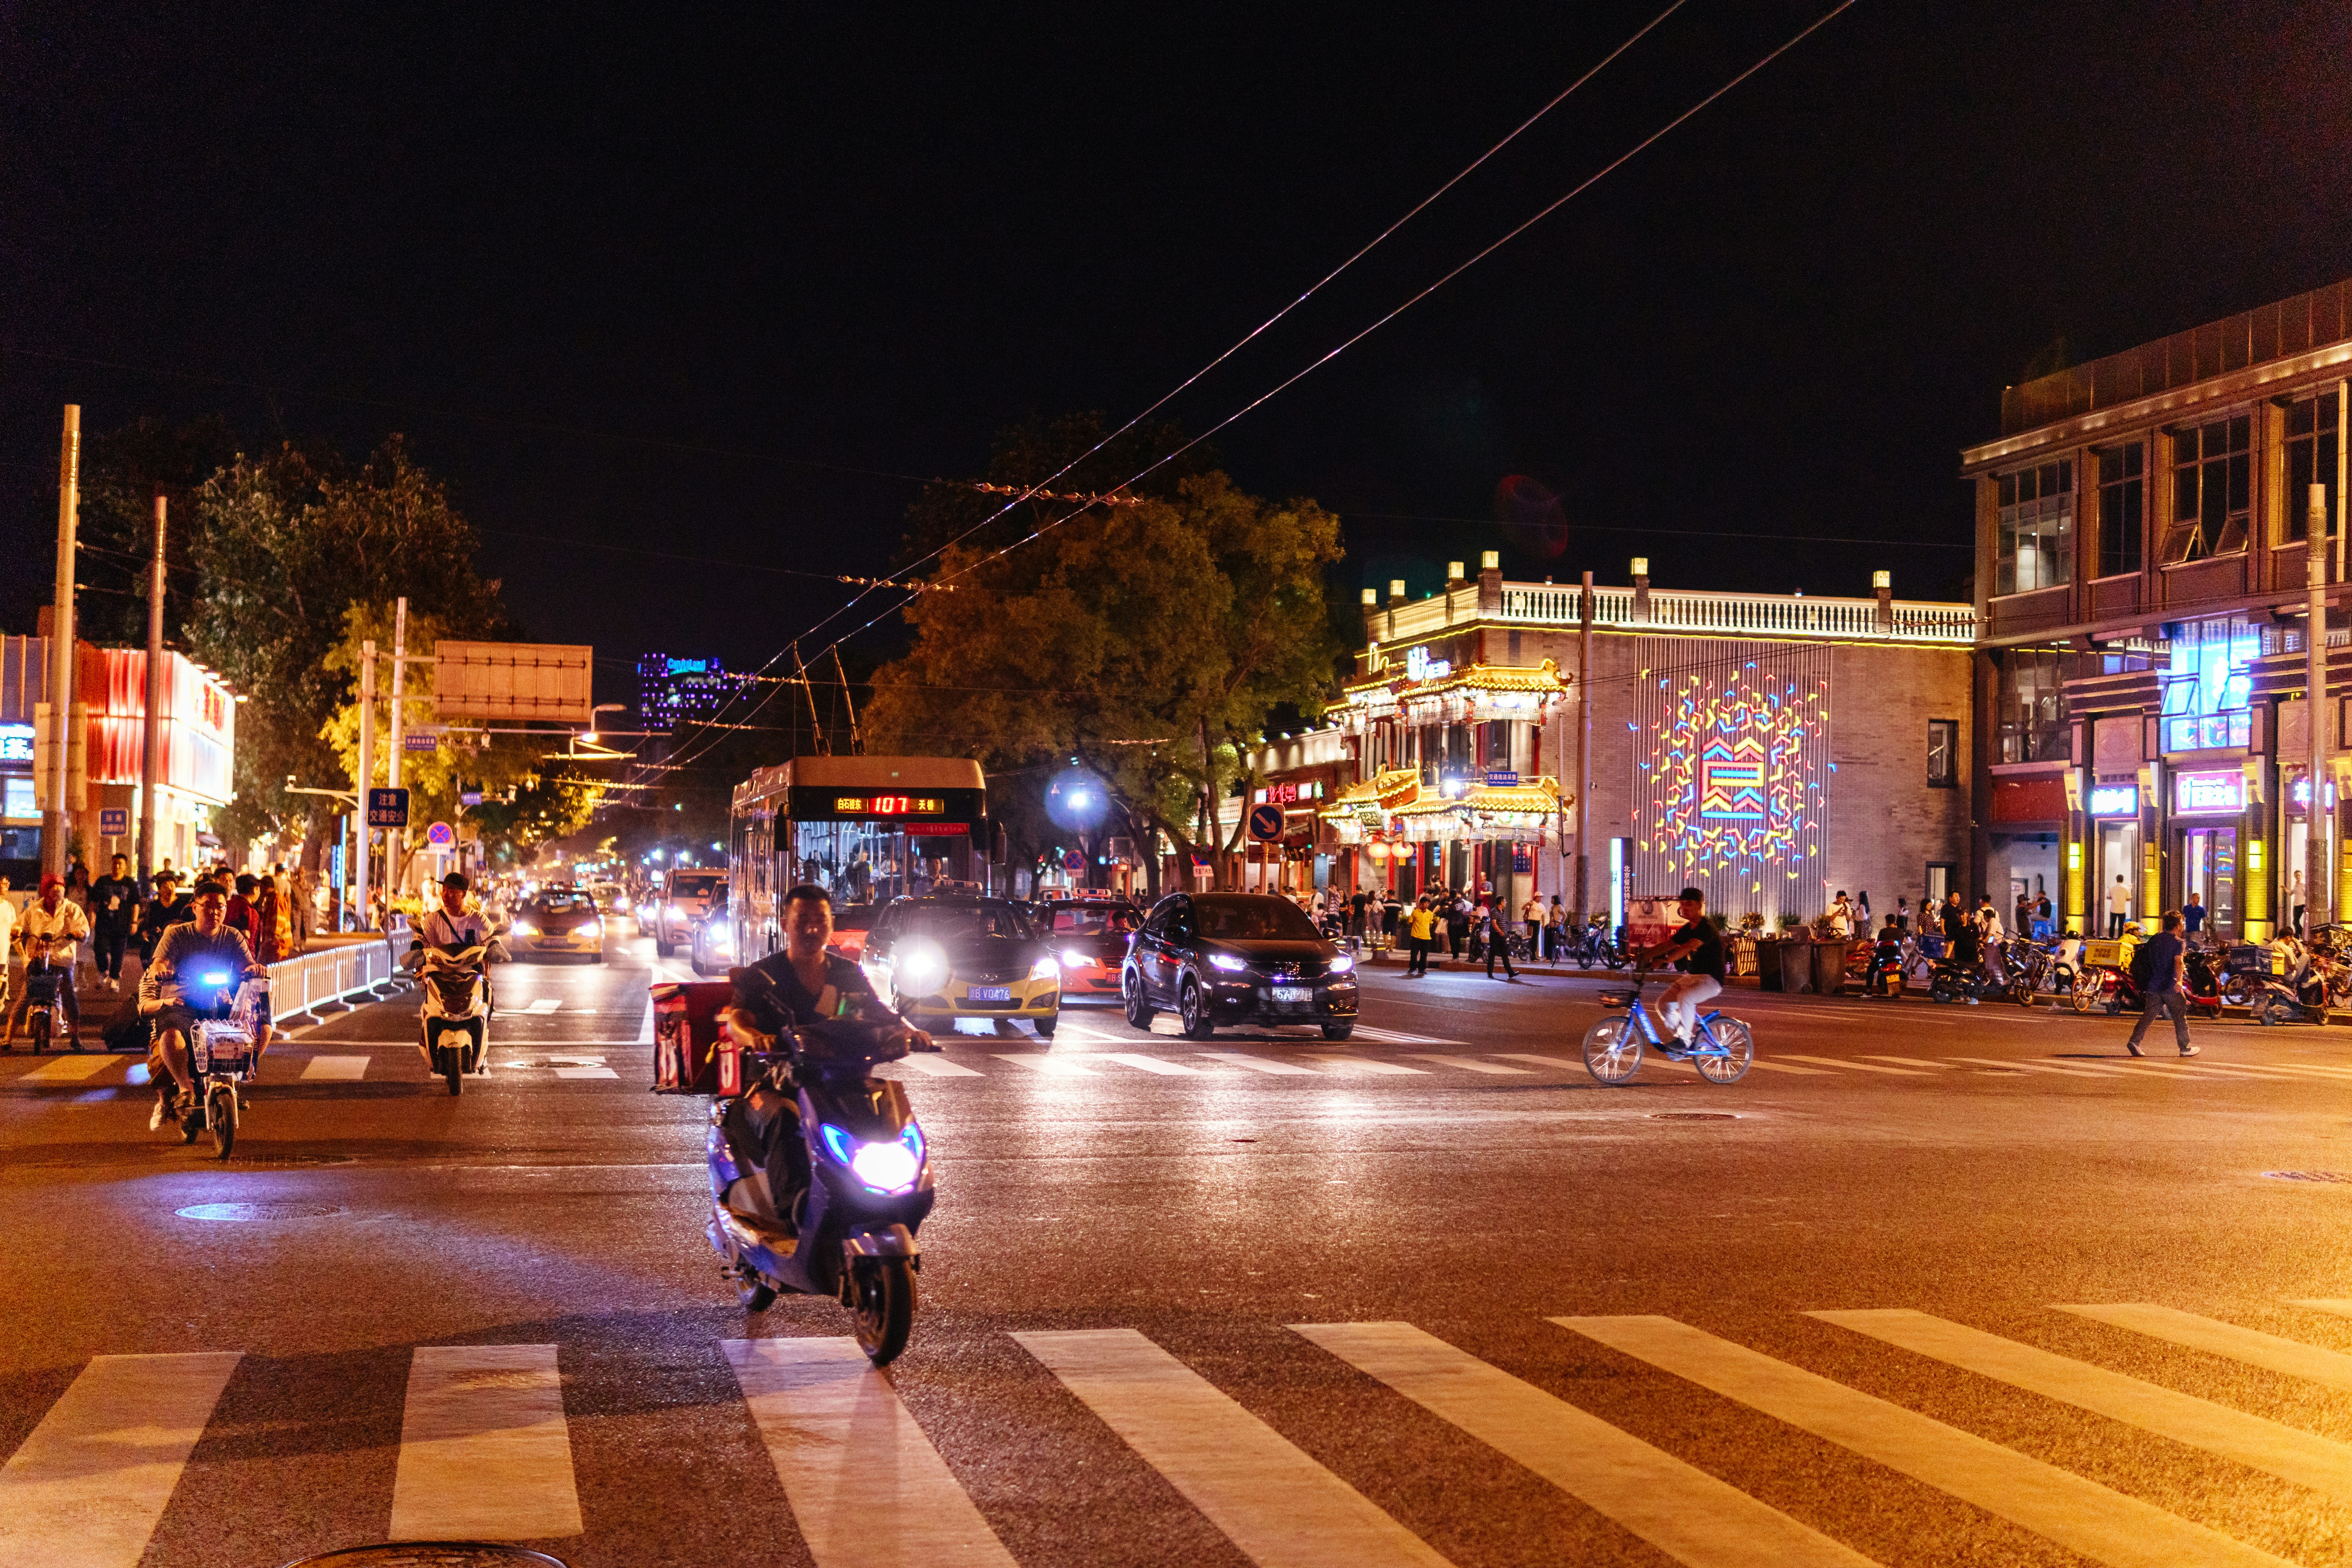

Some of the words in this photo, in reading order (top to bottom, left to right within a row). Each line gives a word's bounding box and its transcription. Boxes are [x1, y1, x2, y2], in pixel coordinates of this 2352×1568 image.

[379, 793, 397, 806] 注意
[838, 798, 861, 810] 白石桥东
[875, 797, 907, 813] 107
[918, 800, 934, 810] 天桥
[369, 809, 405, 822] 交通安全
